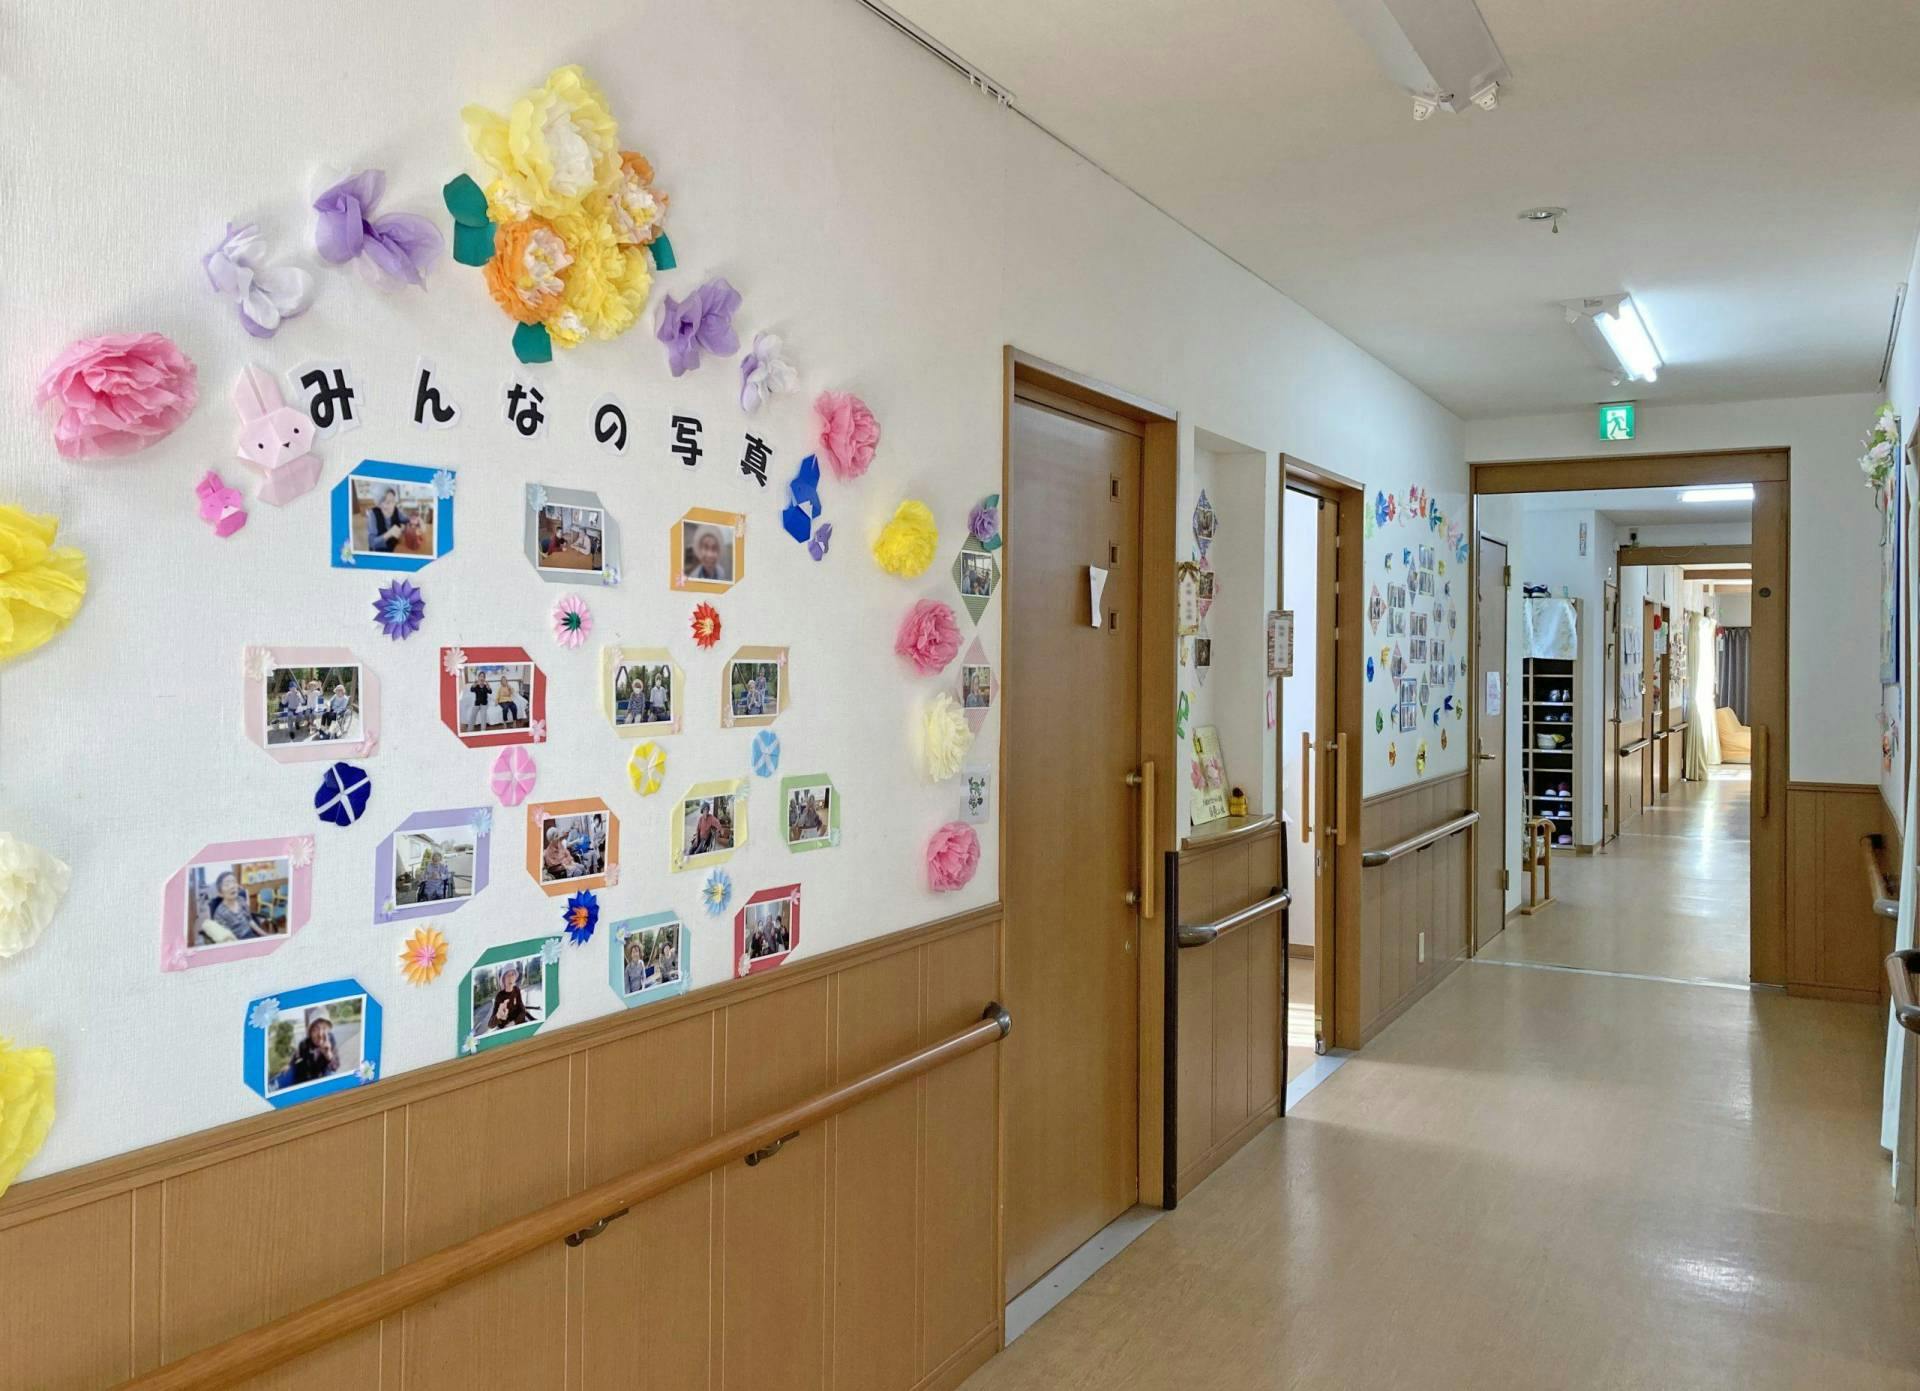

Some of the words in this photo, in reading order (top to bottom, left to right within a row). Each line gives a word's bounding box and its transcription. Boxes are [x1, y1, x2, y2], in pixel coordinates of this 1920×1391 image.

[301, 369, 773, 487] みんなの写真
